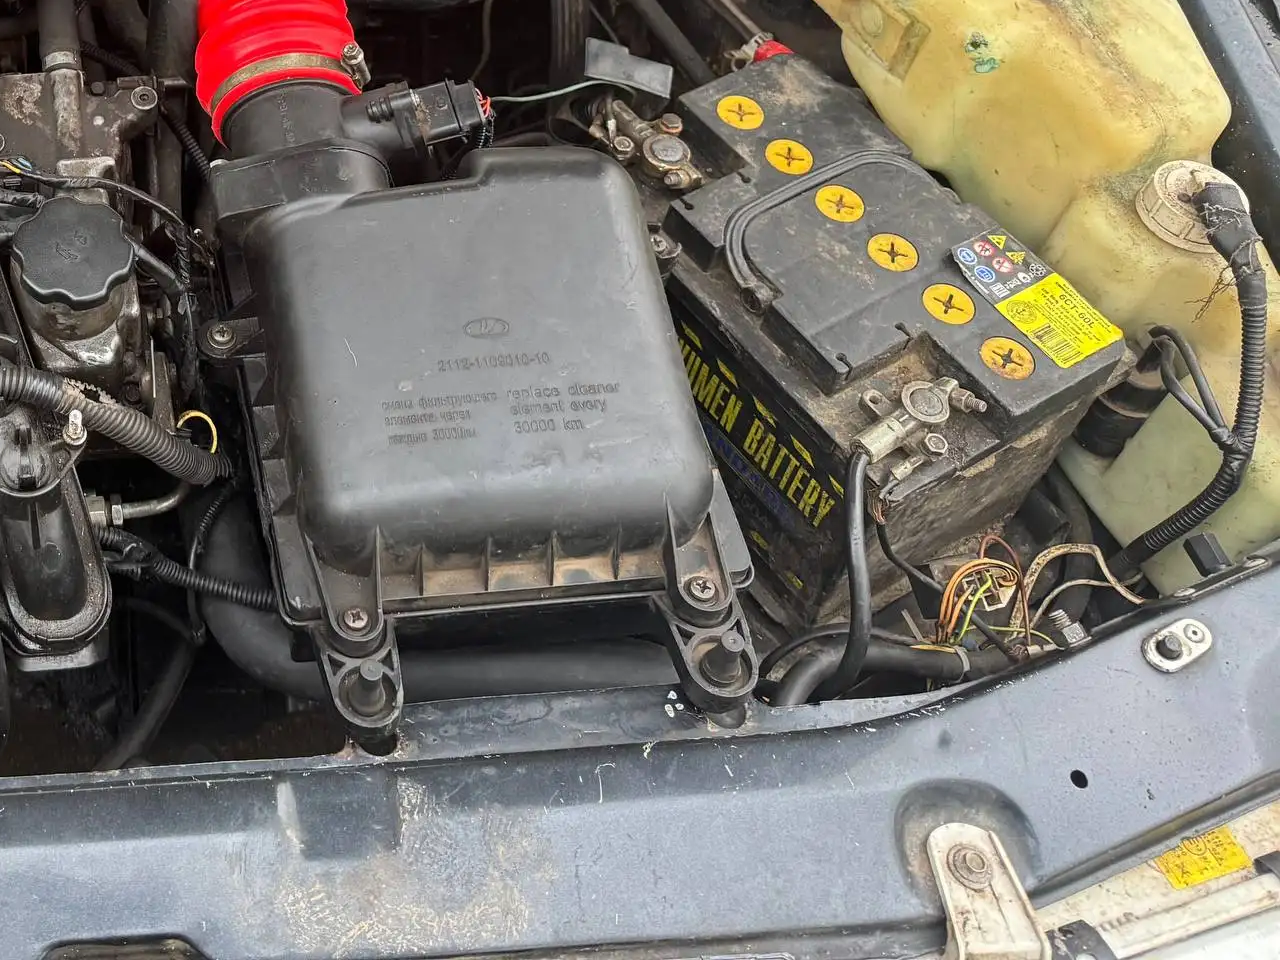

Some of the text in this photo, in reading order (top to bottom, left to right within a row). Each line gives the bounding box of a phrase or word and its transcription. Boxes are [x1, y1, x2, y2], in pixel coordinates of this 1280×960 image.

[506, 382, 620, 402] replace cleaner
[510, 398, 606, 416] element every
[513, 417, 584, 434] 30000 km
[742, 417, 837, 528] BATTERY
